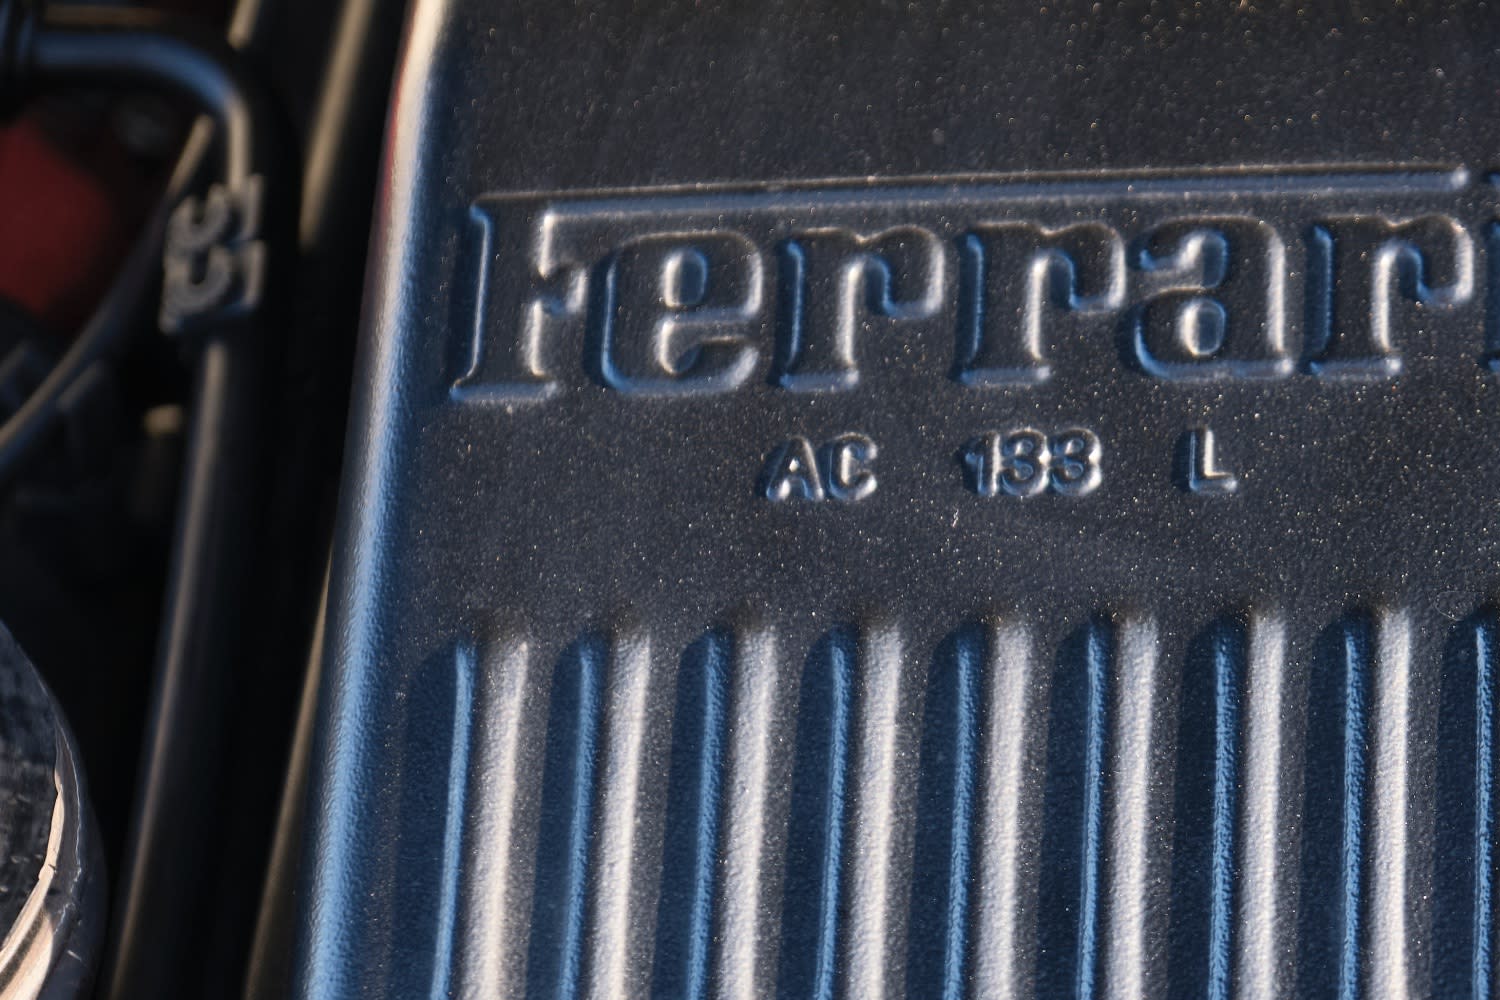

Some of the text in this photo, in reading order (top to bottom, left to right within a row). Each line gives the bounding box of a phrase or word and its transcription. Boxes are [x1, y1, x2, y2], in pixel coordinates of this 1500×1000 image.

[766, 428, 1237, 500] AC 133 L
